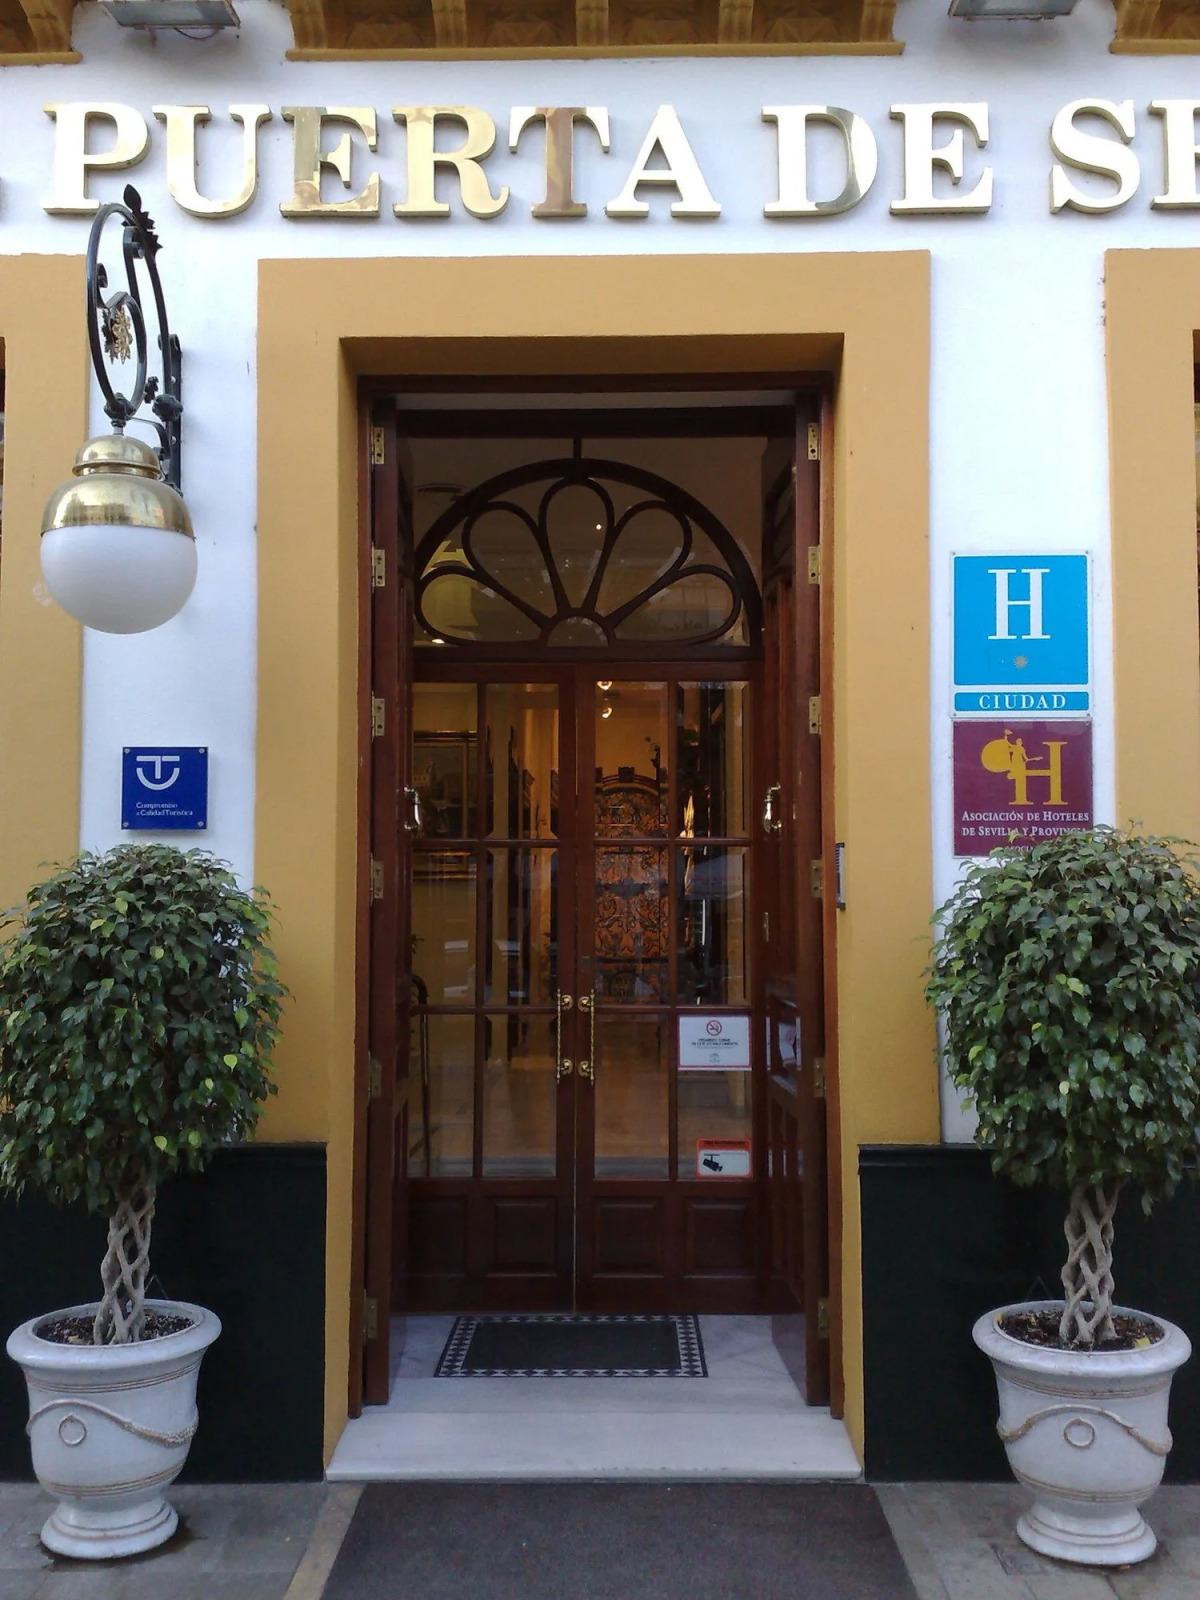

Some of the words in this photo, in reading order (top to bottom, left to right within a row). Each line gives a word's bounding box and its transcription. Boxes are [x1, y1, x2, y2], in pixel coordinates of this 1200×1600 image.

[43, 101, 722, 219] PUERTA
[761, 102, 993, 217] DE
[987, 568, 1051, 640] H
[978, 694, 1066, 709] CIUDAD
[962, 811, 1024, 821] ASOCIACIÓN
[1027, 812, 1040, 821] DE
[1043, 811, 1089, 821] HOTELES
[962, 827, 976, 836] DE
[1022, 828, 1029, 836] Y
